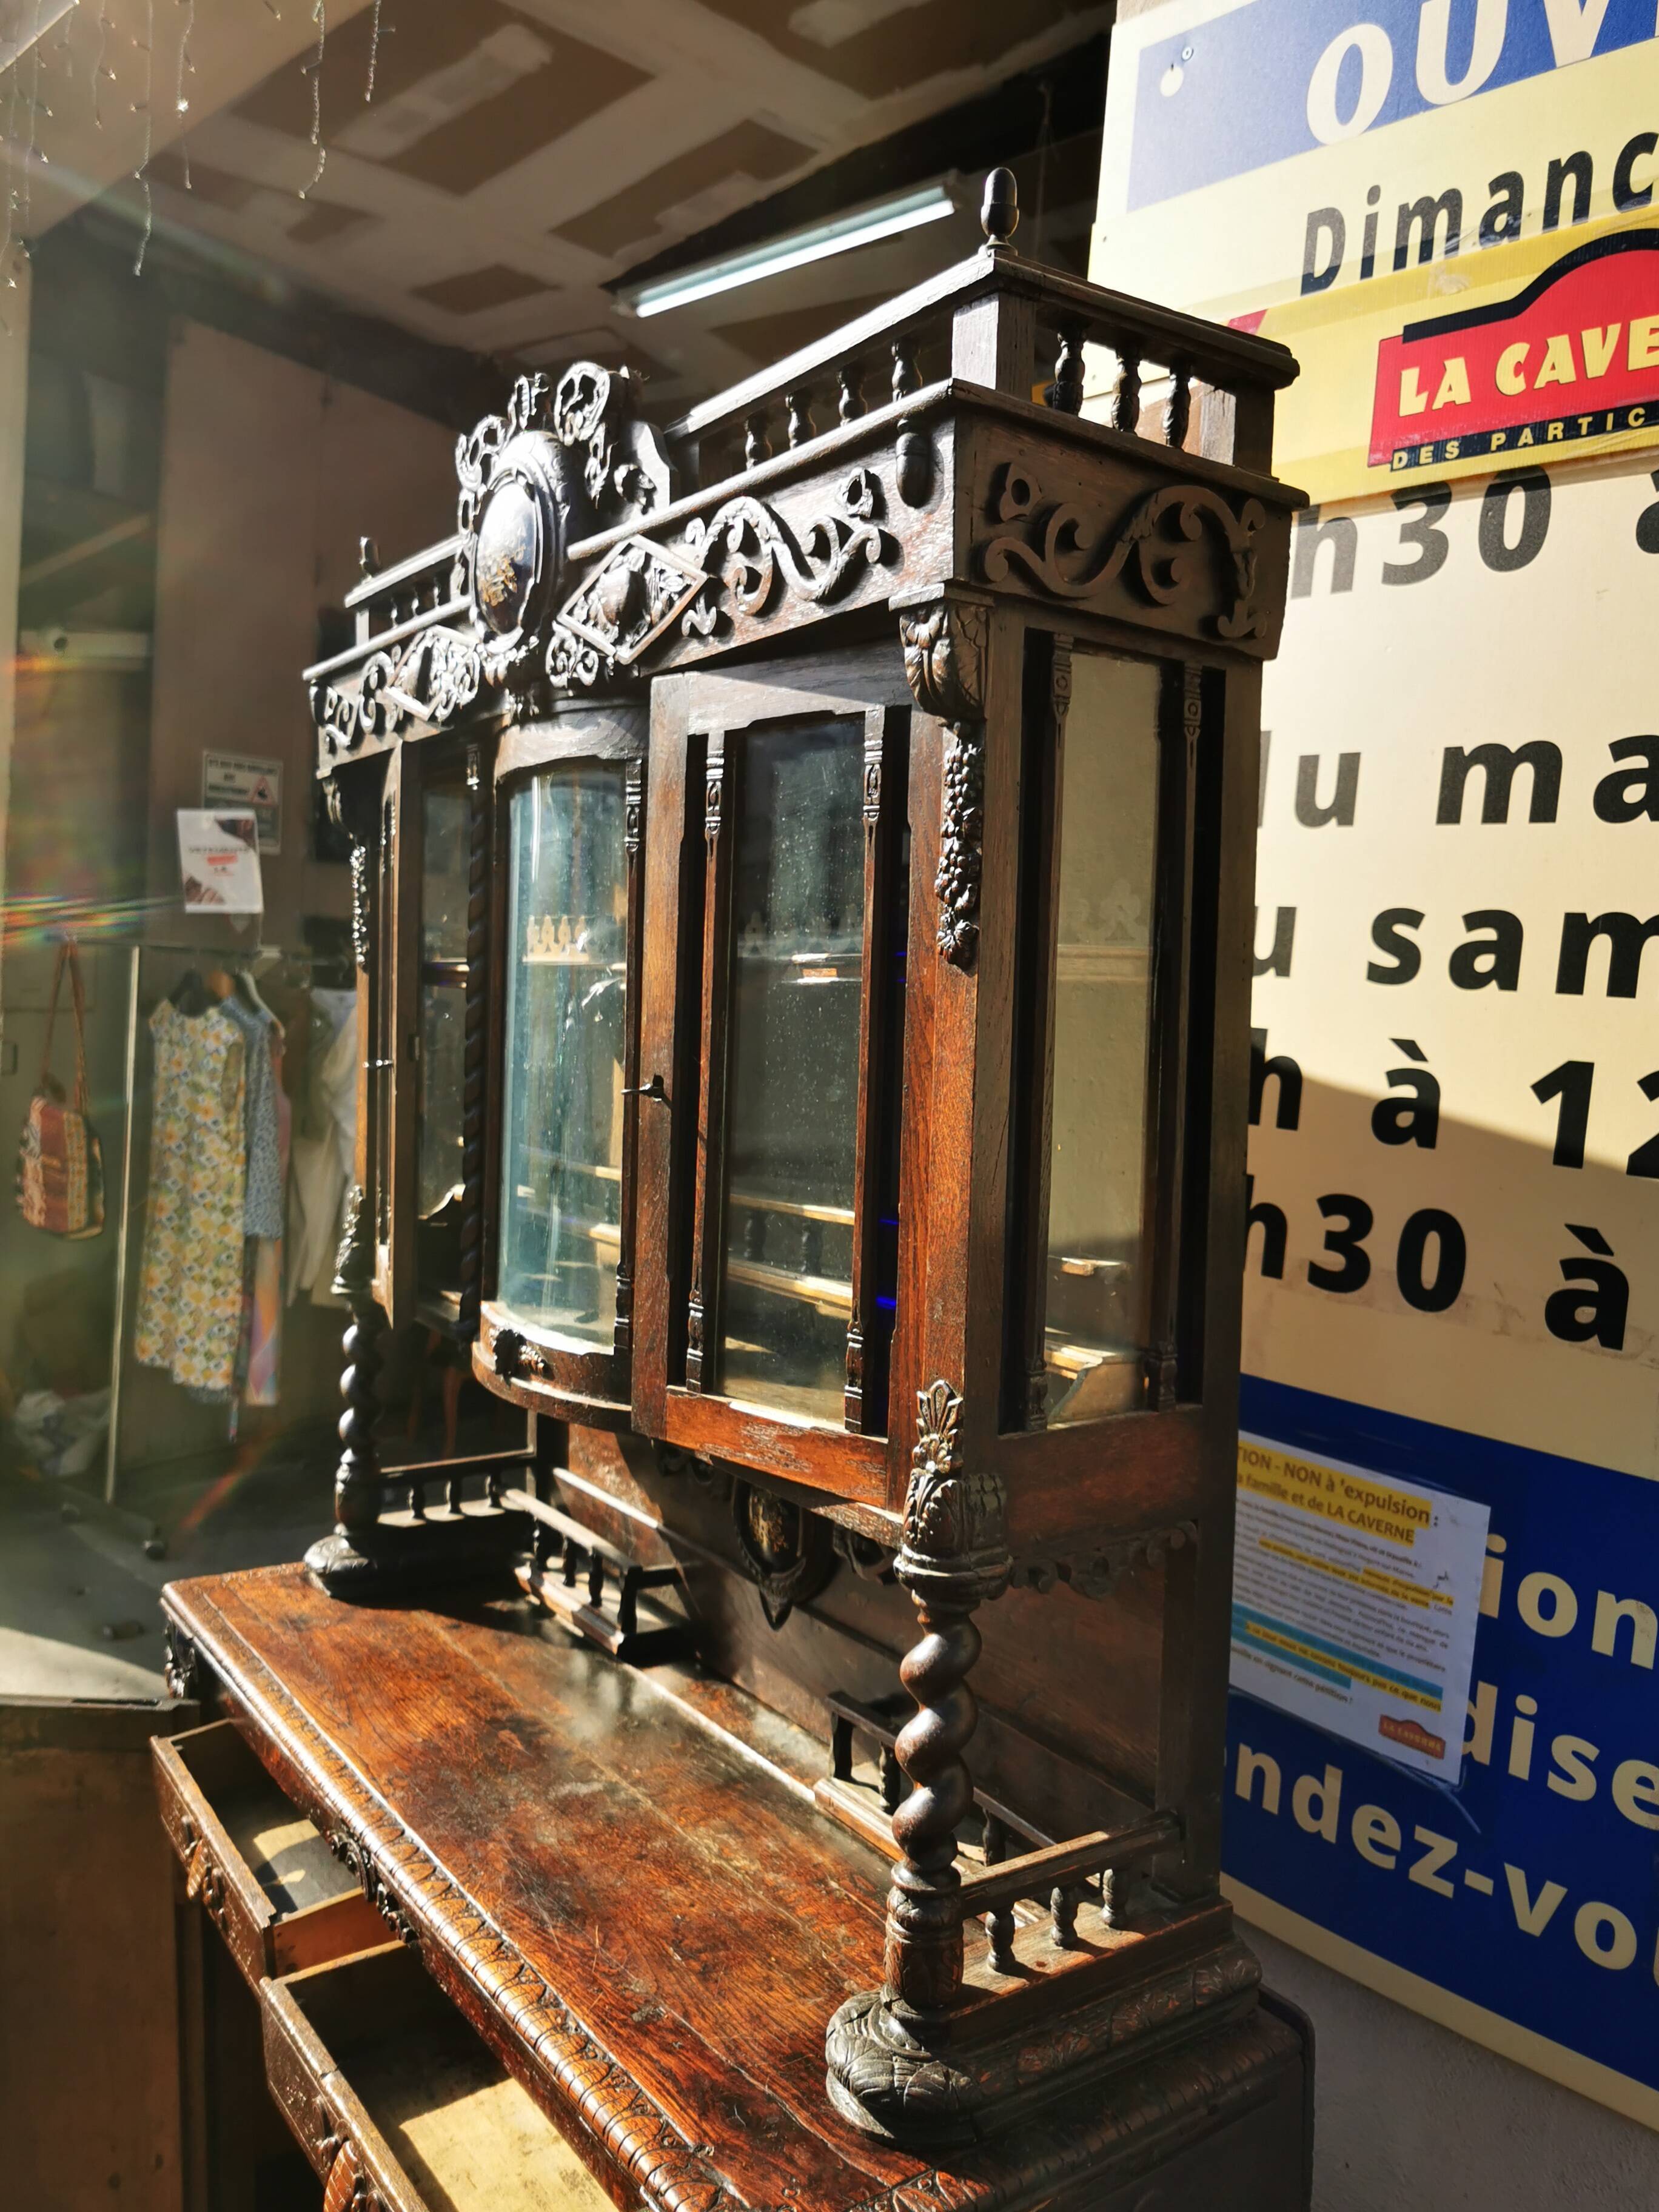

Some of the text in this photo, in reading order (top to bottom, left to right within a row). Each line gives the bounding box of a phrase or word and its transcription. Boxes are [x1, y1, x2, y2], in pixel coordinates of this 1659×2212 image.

[1306, 0, 1659, 146] OUV
[1398, 314, 1659, 417] LA CAVE
[1392, 407, 1646, 470] DES PARTIC
[1435, 734, 1659, 826] ma
[1366, 907, 1659, 999] sam
[1371, 1037, 1441, 1150] à
[1544, 1223, 1630, 1351] à
[1284, 1462, 1322, 1487] NON
[1326, 1474, 1335, 1493] à
[1291, 1492, 1304, 1506] et
[1307, 1495, 1324, 1512] de
[1327, 1502, 1344, 1520] LA
[1347, 1510, 1416, 1544] CAVERNE
[1224, 1741, 1659, 1989] ndez-vo
